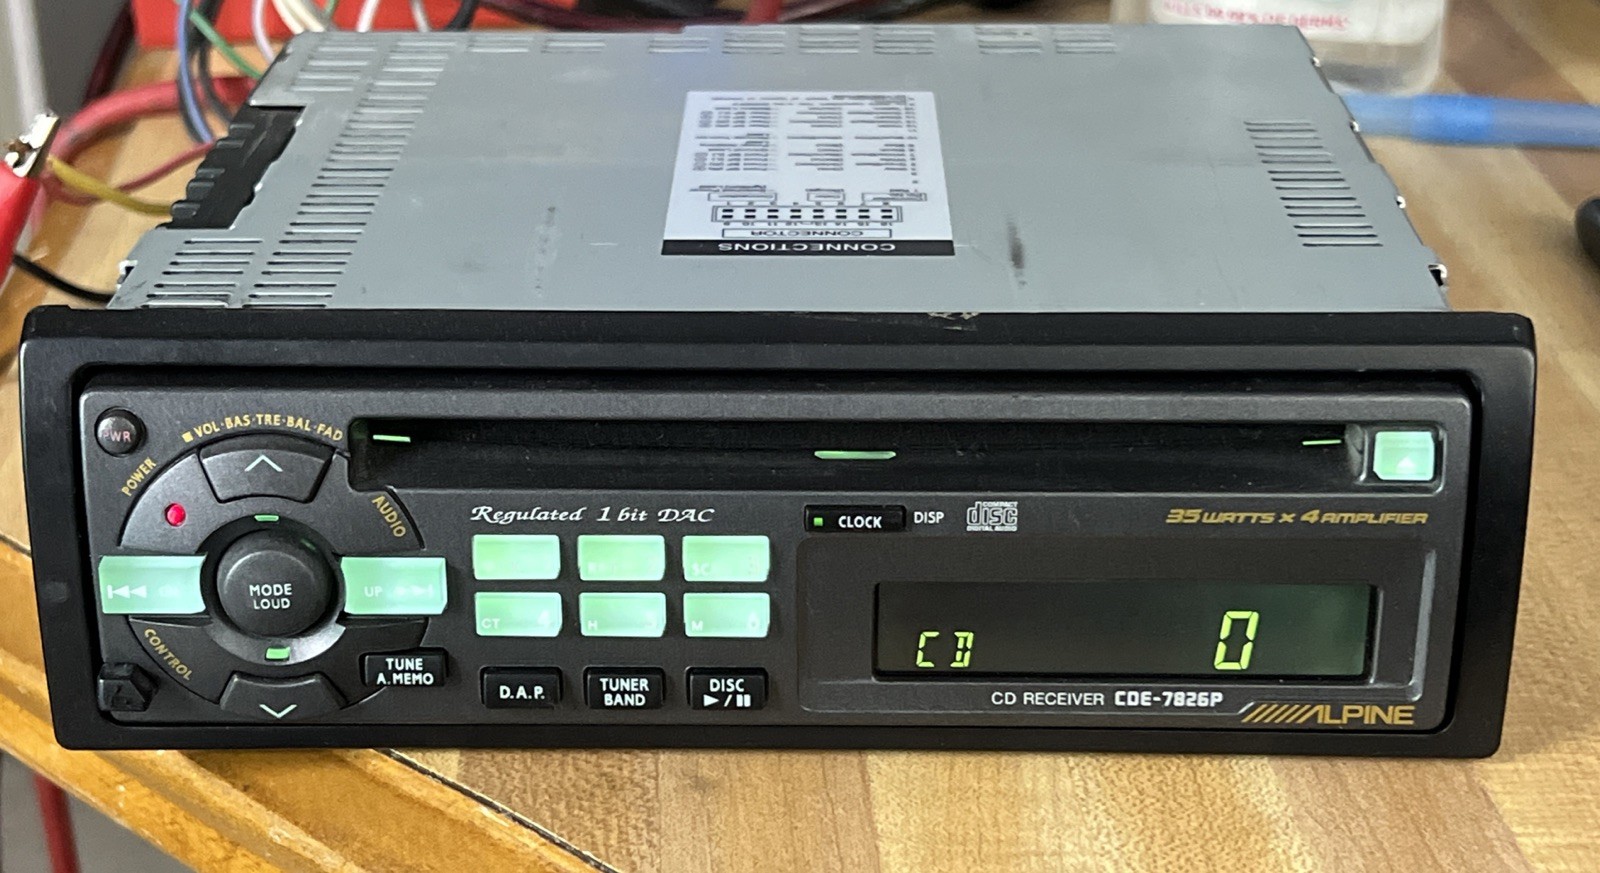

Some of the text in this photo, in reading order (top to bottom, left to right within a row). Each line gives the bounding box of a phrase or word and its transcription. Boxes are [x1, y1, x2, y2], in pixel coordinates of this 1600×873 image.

[751, 229, 863, 237] CONNECTOR
[718, 243, 896, 252] CONNECTIONS
[103, 428, 132, 443] PWR
[121, 457, 157, 496] POWER
[372, 496, 407, 538] AUDIO
[470, 505, 716, 525] Regulated 1 bit DAC
[914, 511, 945, 524] DISP
[966, 502, 1018, 526] disc
[838, 515, 882, 528] CLOCK
[249, 583, 293, 597] MODE
[364, 587, 383, 598] UP
[253, 598, 291, 610] LOUD
[481, 618, 500, 629] CT
[588, 620, 598, 630] H
[691, 620, 704, 631] M
[1214, 610, 1259, 671] 0
[143, 628, 194, 680] CONTROL
[914, 631, 975, 668] CD
[385, 658, 424, 671] TUNE
[599, 677, 650, 692] TUNER
[709, 678, 745, 692] DISC
[499, 684, 545, 700] D.A.P.
[991, 689, 1224, 707] CD RECEIVER CDE-7826P
[604, 693, 646, 707] BAND
[1307, 705, 1416, 726] ALPINE
